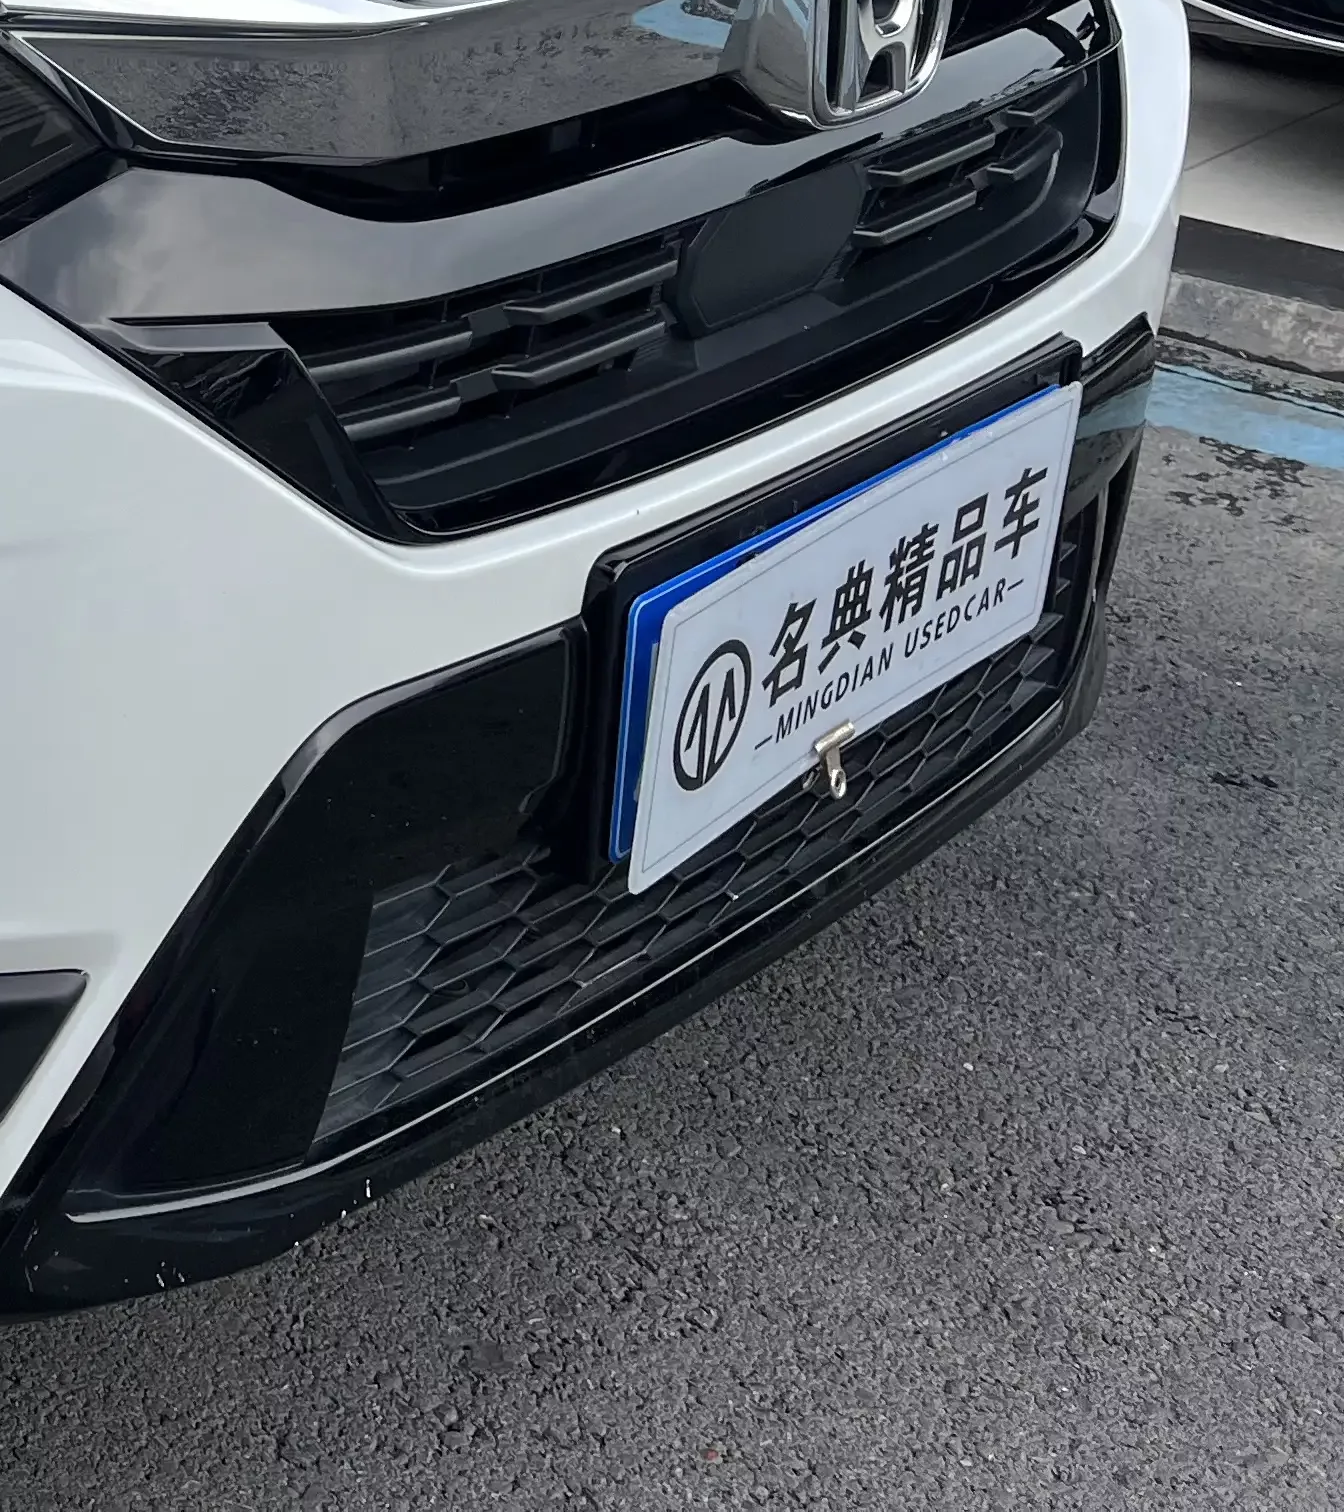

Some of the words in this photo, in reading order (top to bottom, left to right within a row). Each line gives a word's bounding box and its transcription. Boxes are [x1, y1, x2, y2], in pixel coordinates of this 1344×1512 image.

[761, 466, 1048, 708] 名典精品车
[775, 648, 893, 745] MINGDIAN
[904, 581, 1007, 659] USEDCAR
